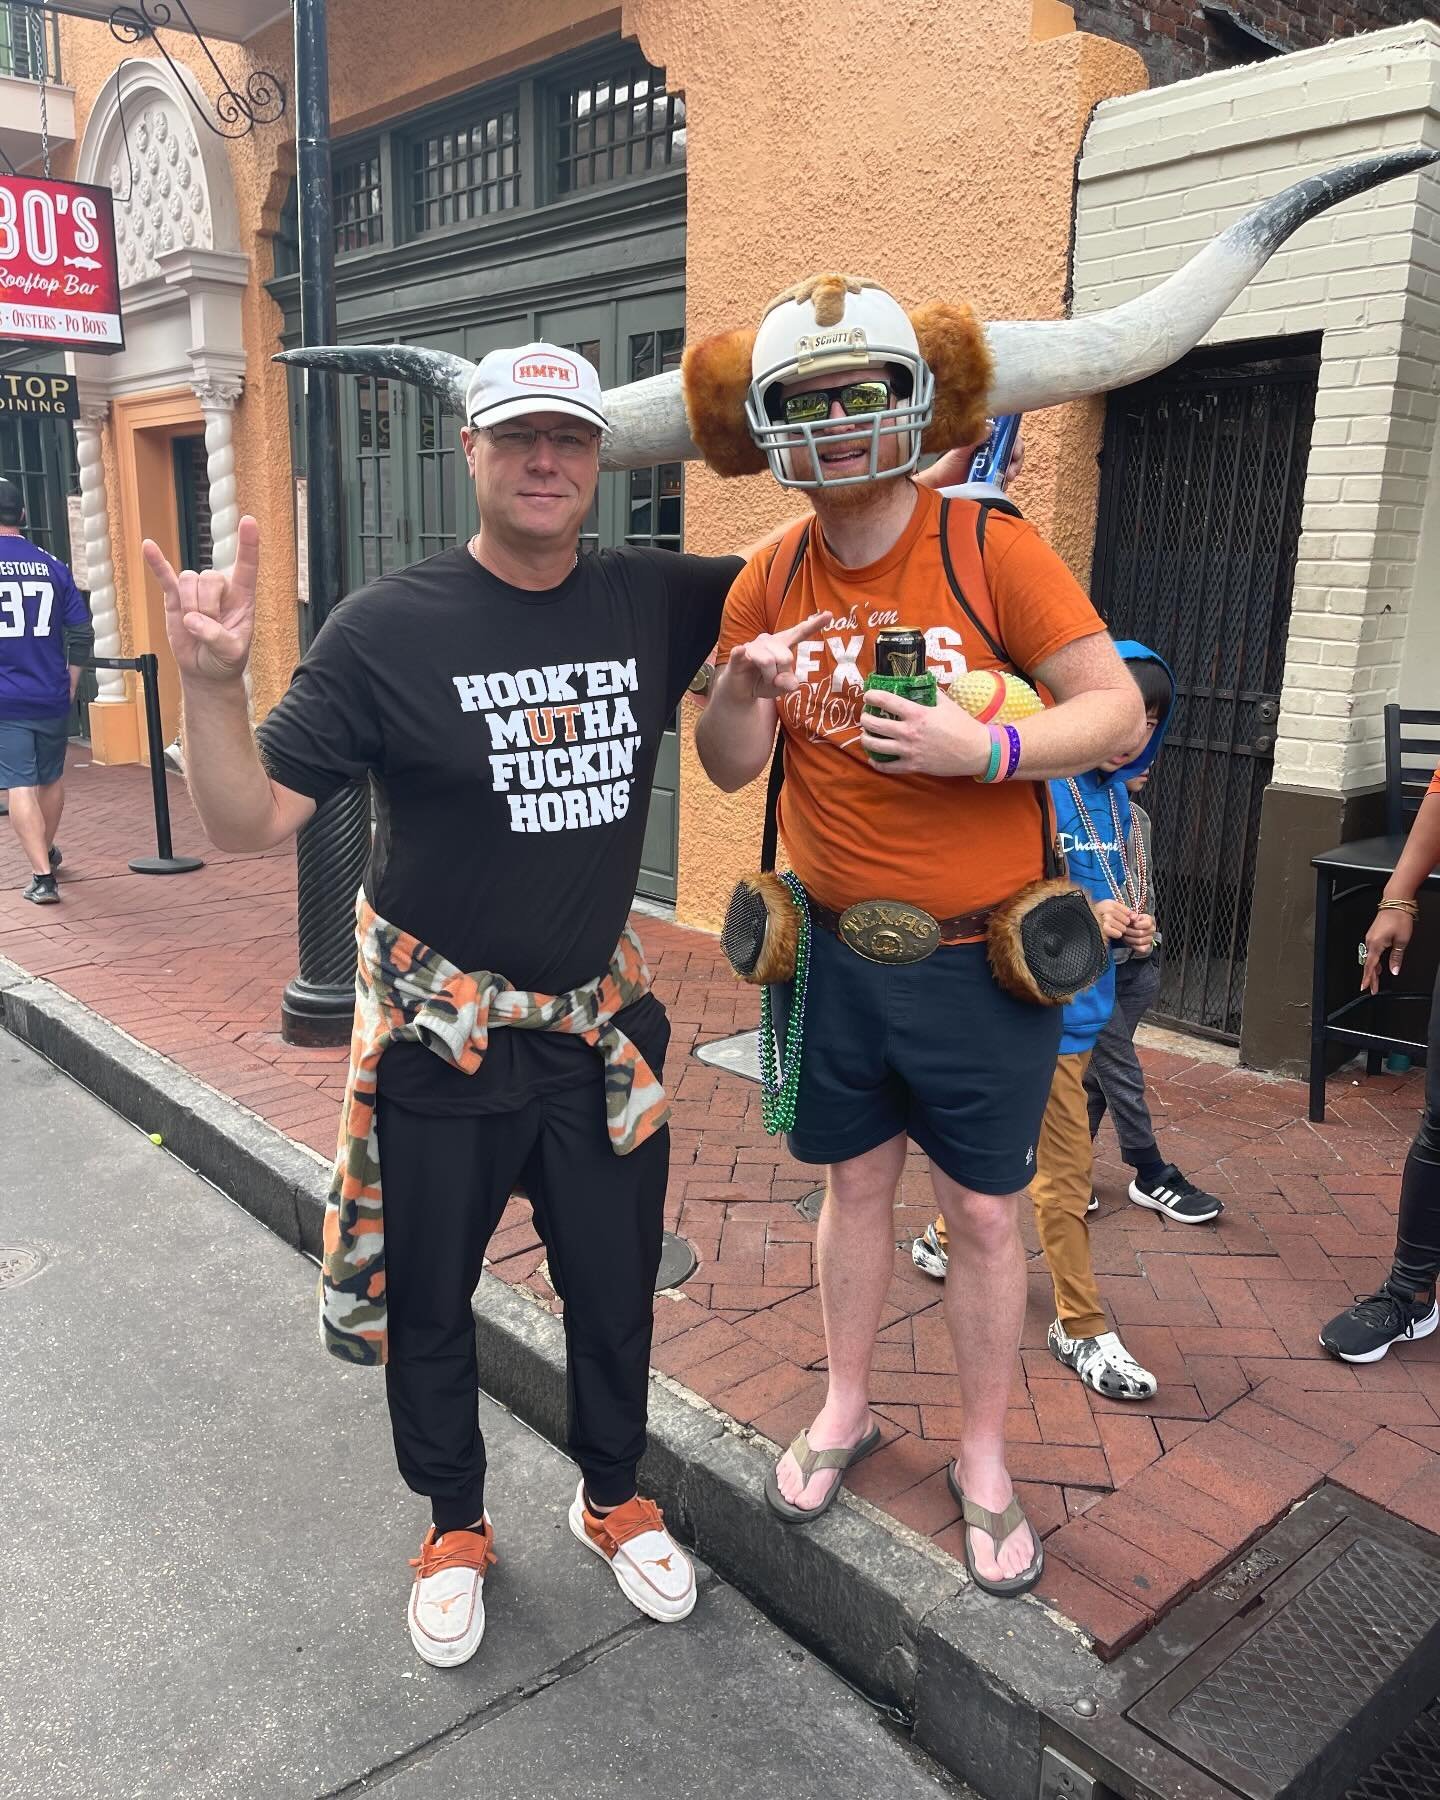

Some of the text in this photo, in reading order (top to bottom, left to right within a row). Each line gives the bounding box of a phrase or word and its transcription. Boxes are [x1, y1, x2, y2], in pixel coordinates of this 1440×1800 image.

[63, 273, 99, 296] Bar
[0, 374, 70, 400] TOP
[518, 364, 570, 382] HMFH
[0, 561, 50, 577] ESTOVER
[0, 581, 54, 638] 37
[452, 657, 639, 713] HOOK'EM
[484, 696, 638, 750] MUTHA
[488, 735, 642, 792] FUCKIN'
